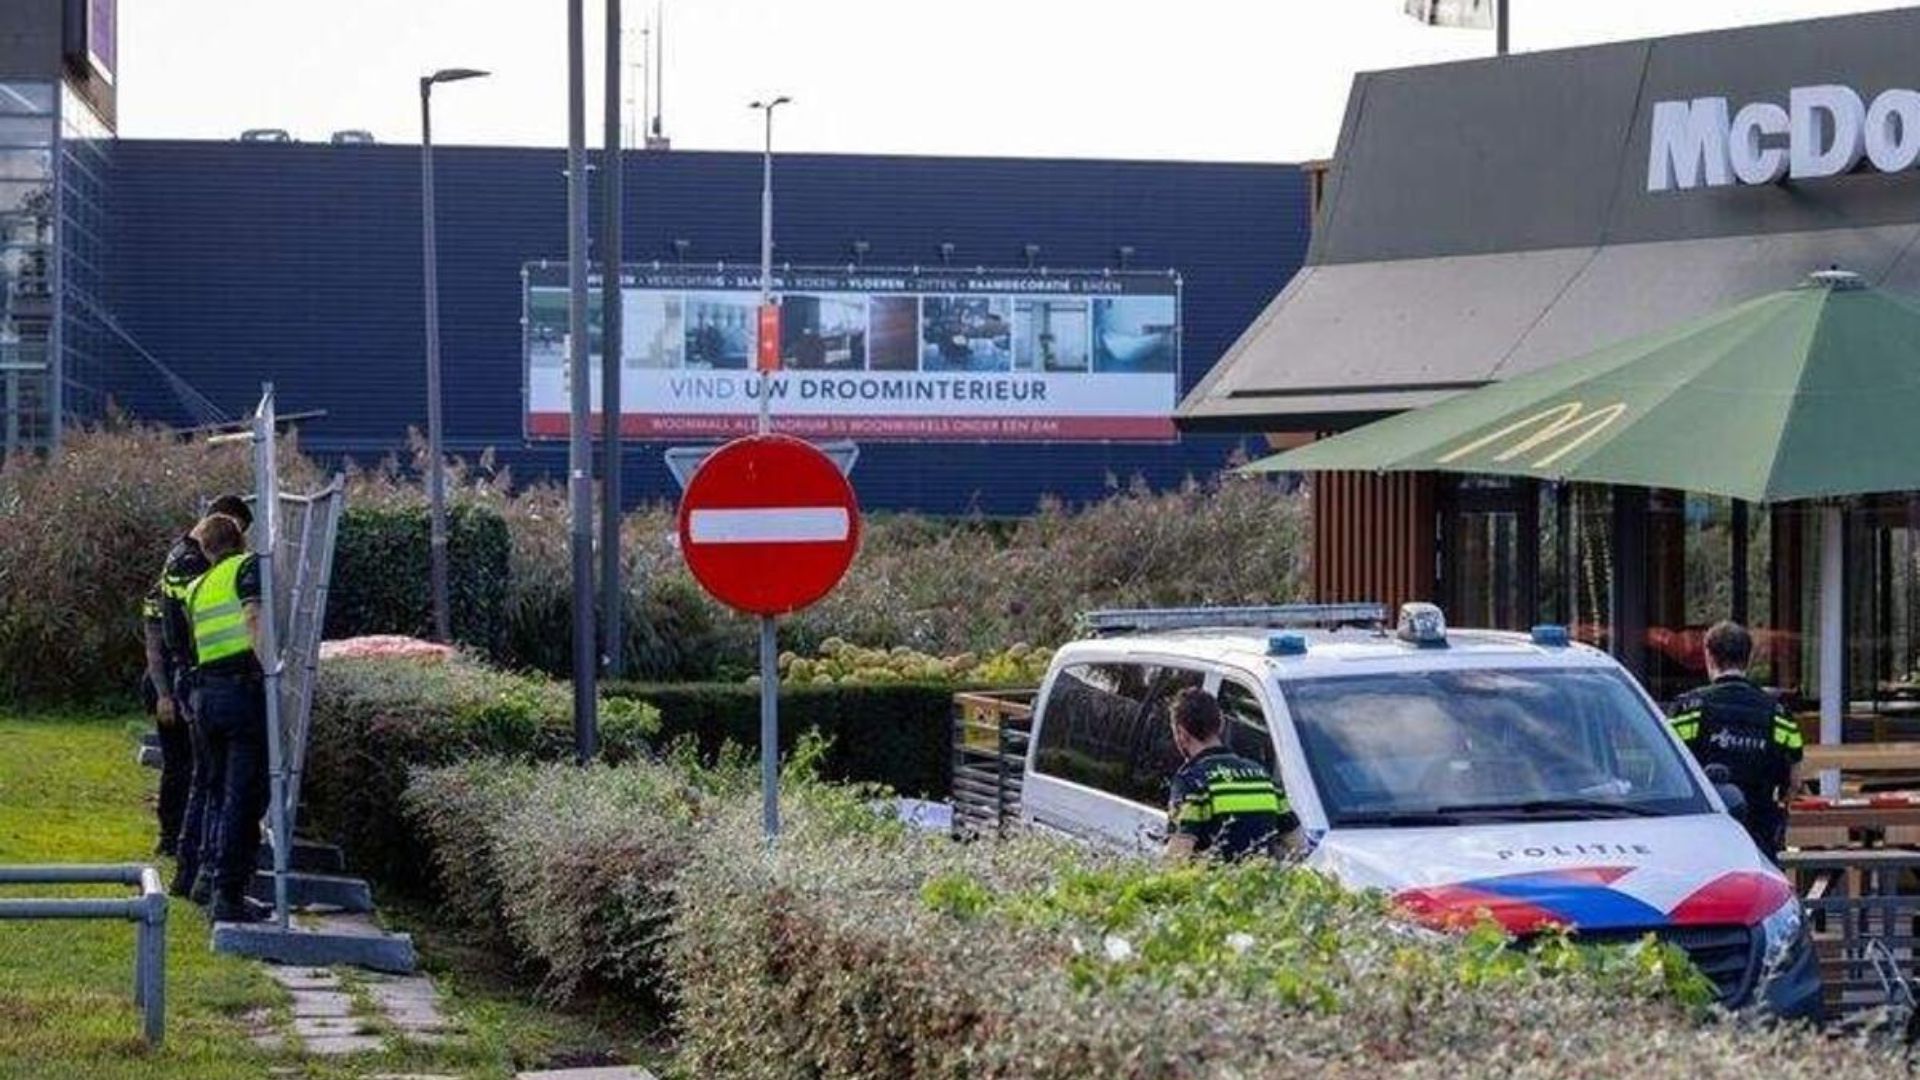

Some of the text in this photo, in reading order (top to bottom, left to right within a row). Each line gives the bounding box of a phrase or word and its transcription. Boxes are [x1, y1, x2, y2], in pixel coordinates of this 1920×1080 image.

[1648, 84, 1920, 191] McDo
[848, 278, 905, 289] VLOEREN
[968, 279, 1069, 291] RAAMDECORATIE
[671, 378, 1047, 401] VIND UW DROOMINTERIEUR
[1497, 843, 1651, 860] POLITIE
